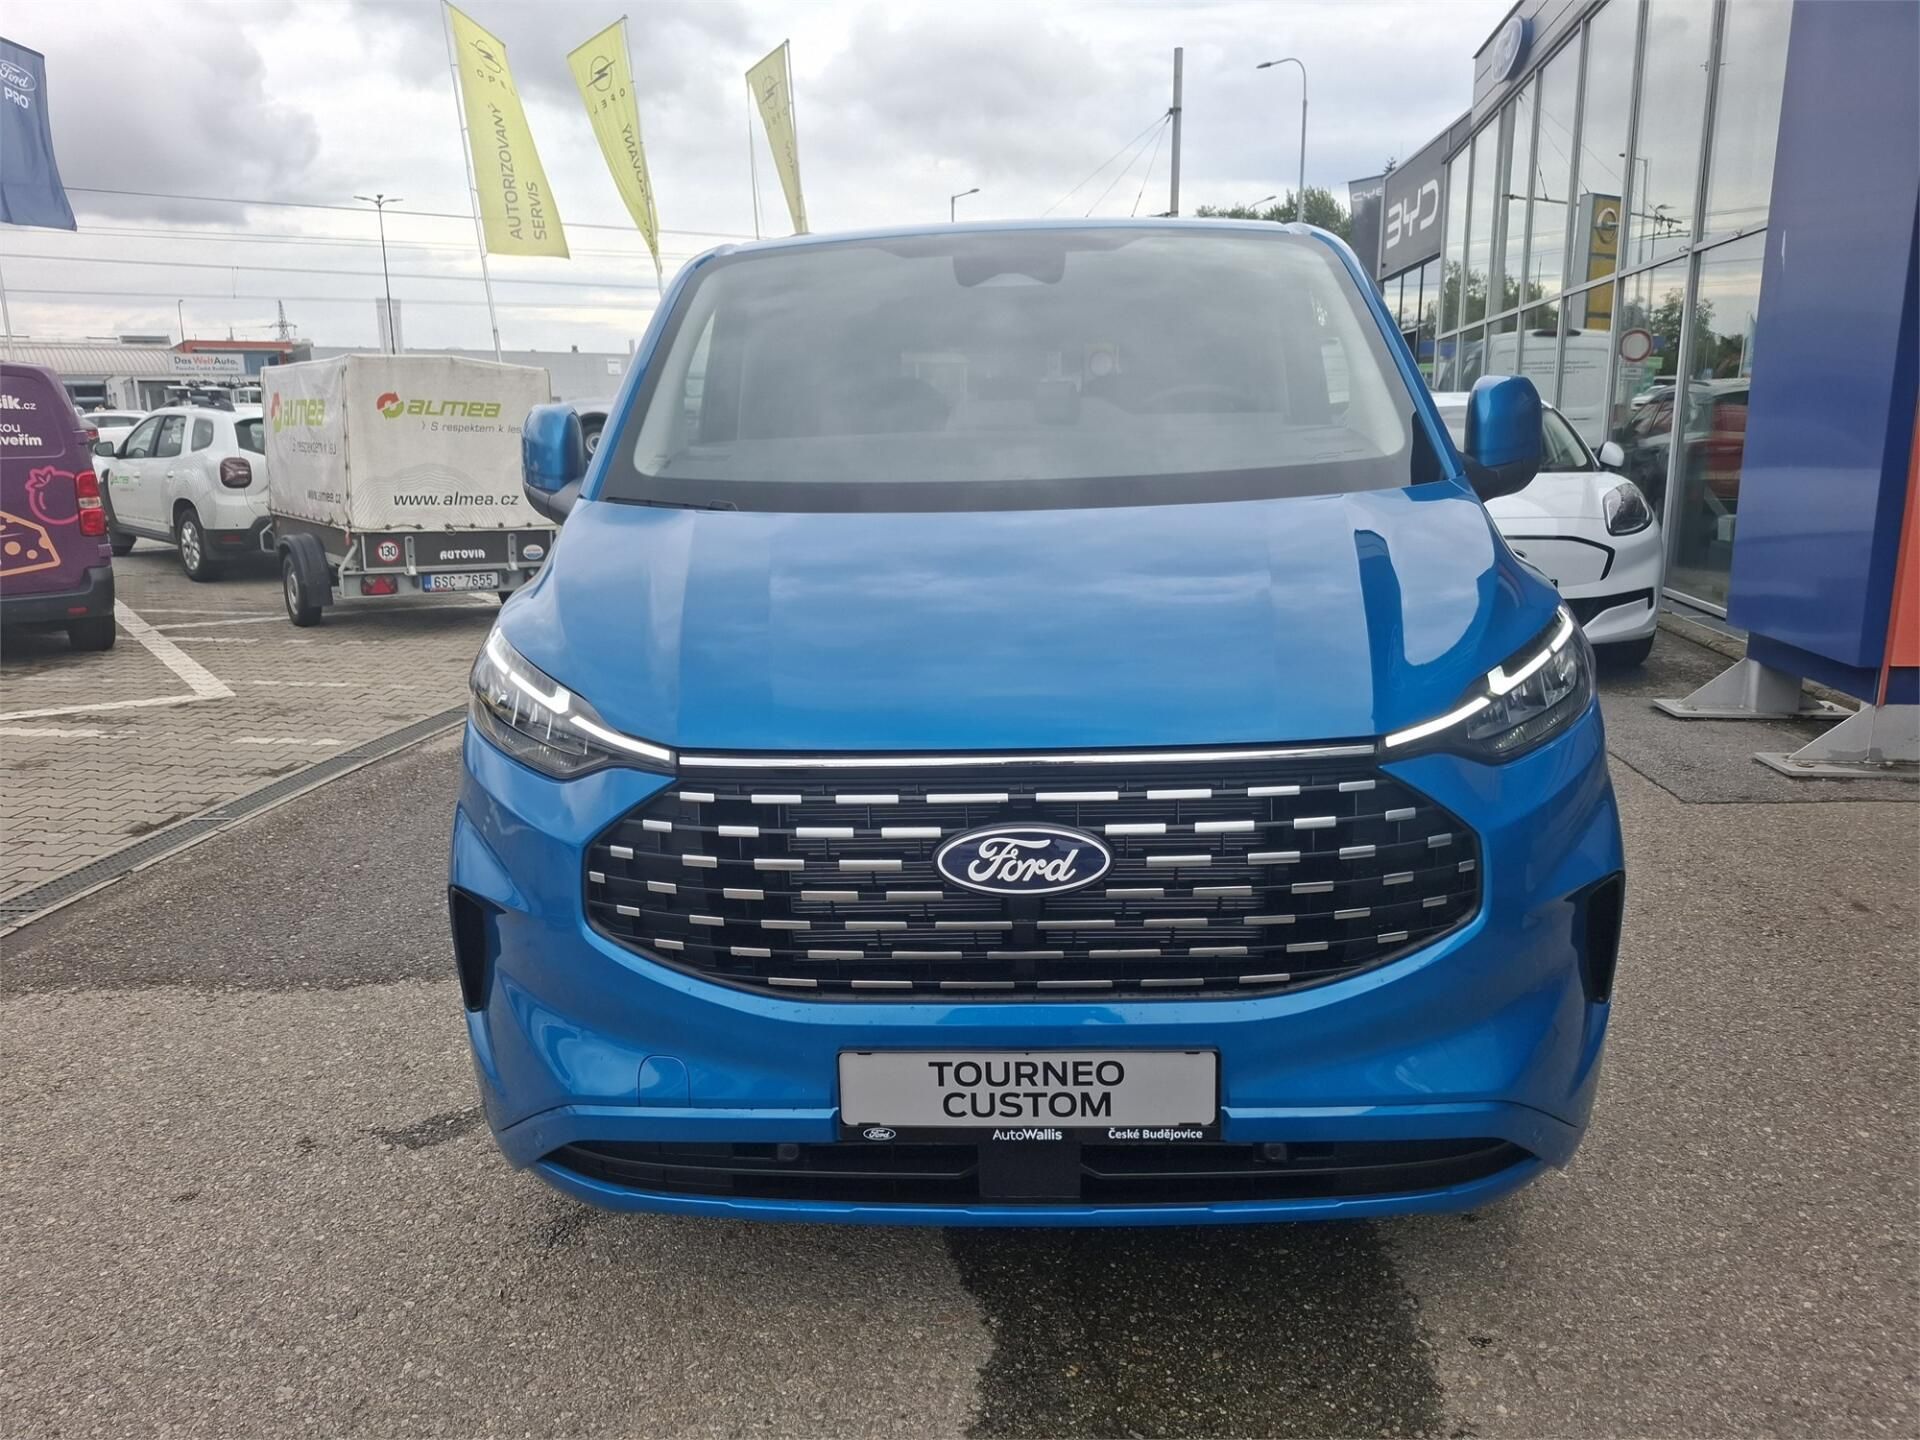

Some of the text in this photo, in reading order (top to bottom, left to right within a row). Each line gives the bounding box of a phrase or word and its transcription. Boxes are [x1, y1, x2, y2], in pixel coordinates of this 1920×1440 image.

[0, 63, 29, 88] Ford
[4, 86, 29, 109] PRO
[488, 103, 523, 240] AUTORIZOVANÝ
[526, 181, 547, 240] SERVIS
[1386, 179, 1439, 249] BYD
[431, 422, 439, 431] S
[442, 423, 495, 434] respektem
[498, 424, 504, 433] k
[0, 433, 42, 446] veřím
[393, 491, 519, 506] www.almea.cz
[381, 545, 397, 557] 130
[439, 549, 486, 560] AUTOVIA
[434, 575, 456, 588] 6SC
[465, 574, 493, 586] 7655
[967, 836, 1079, 882] Ford
[928, 1060, 1125, 1087] TOURNEO
[942, 1091, 1112, 1118] CUSTOM
[867, 1128, 892, 1139] Ford
[992, 1128, 1063, 1141] AutoWallis
[1108, 1127, 1203, 1142] České Budějovice
